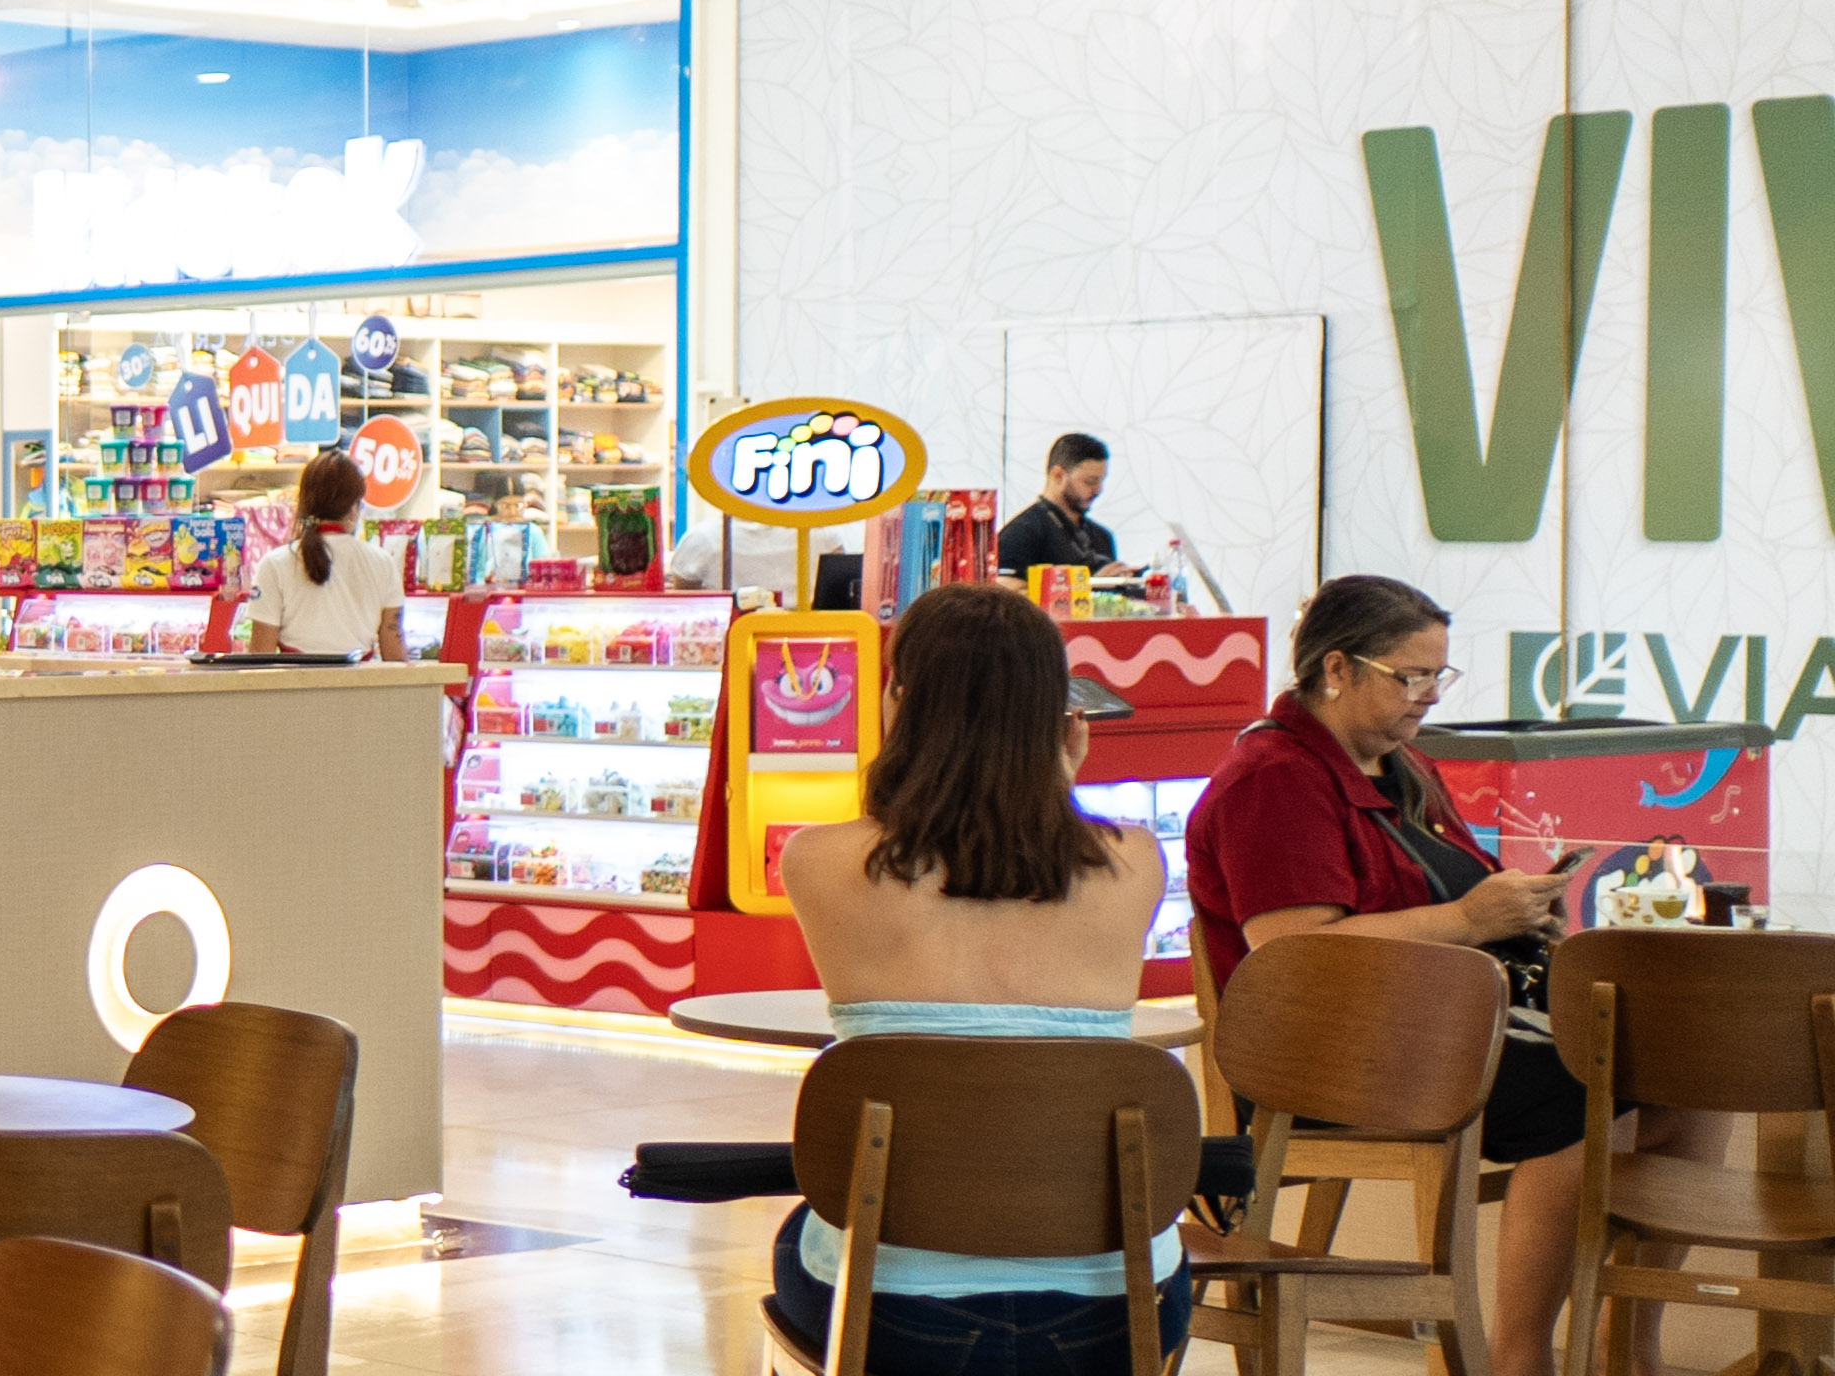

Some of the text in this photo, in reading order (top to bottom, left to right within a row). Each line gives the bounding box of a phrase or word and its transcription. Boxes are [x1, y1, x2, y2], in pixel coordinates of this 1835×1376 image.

[179, 374, 337, 454] LI QUI DA
[353, 436, 417, 484] 50%
[731, 419, 884, 502] Fini
